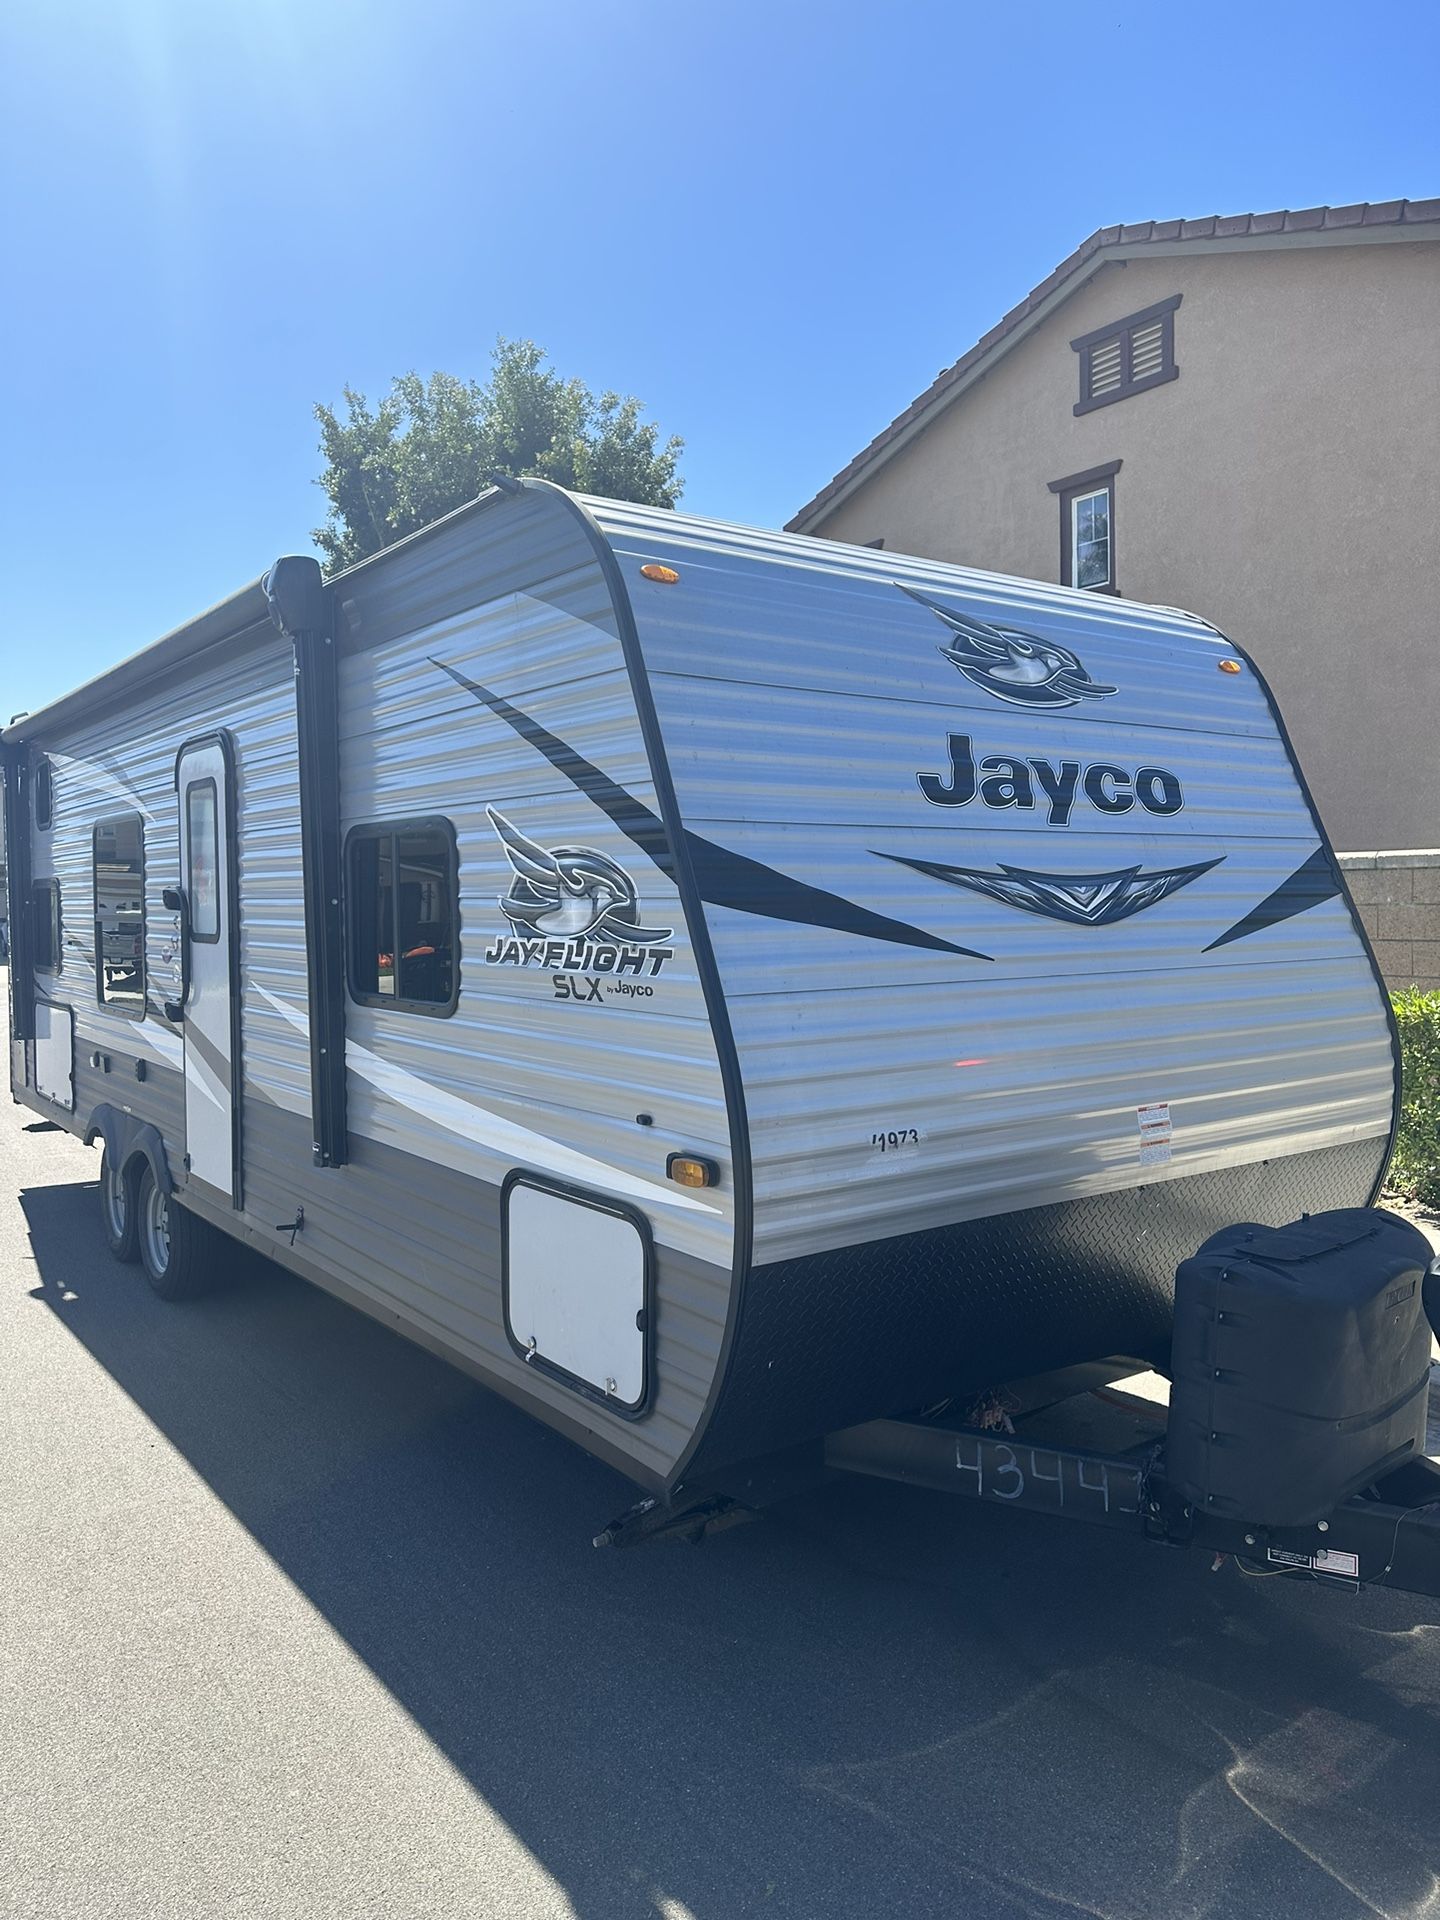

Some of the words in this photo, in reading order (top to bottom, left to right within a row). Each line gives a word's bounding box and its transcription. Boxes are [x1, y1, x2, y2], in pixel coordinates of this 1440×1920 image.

[917, 732, 1185, 827] Jayco
[485, 936, 541, 967] JAY
[541, 938, 674, 977] FLIGHT
[552, 974, 604, 1002] SLX
[606, 985, 615, 994] by
[614, 979, 654, 998] Jayco
